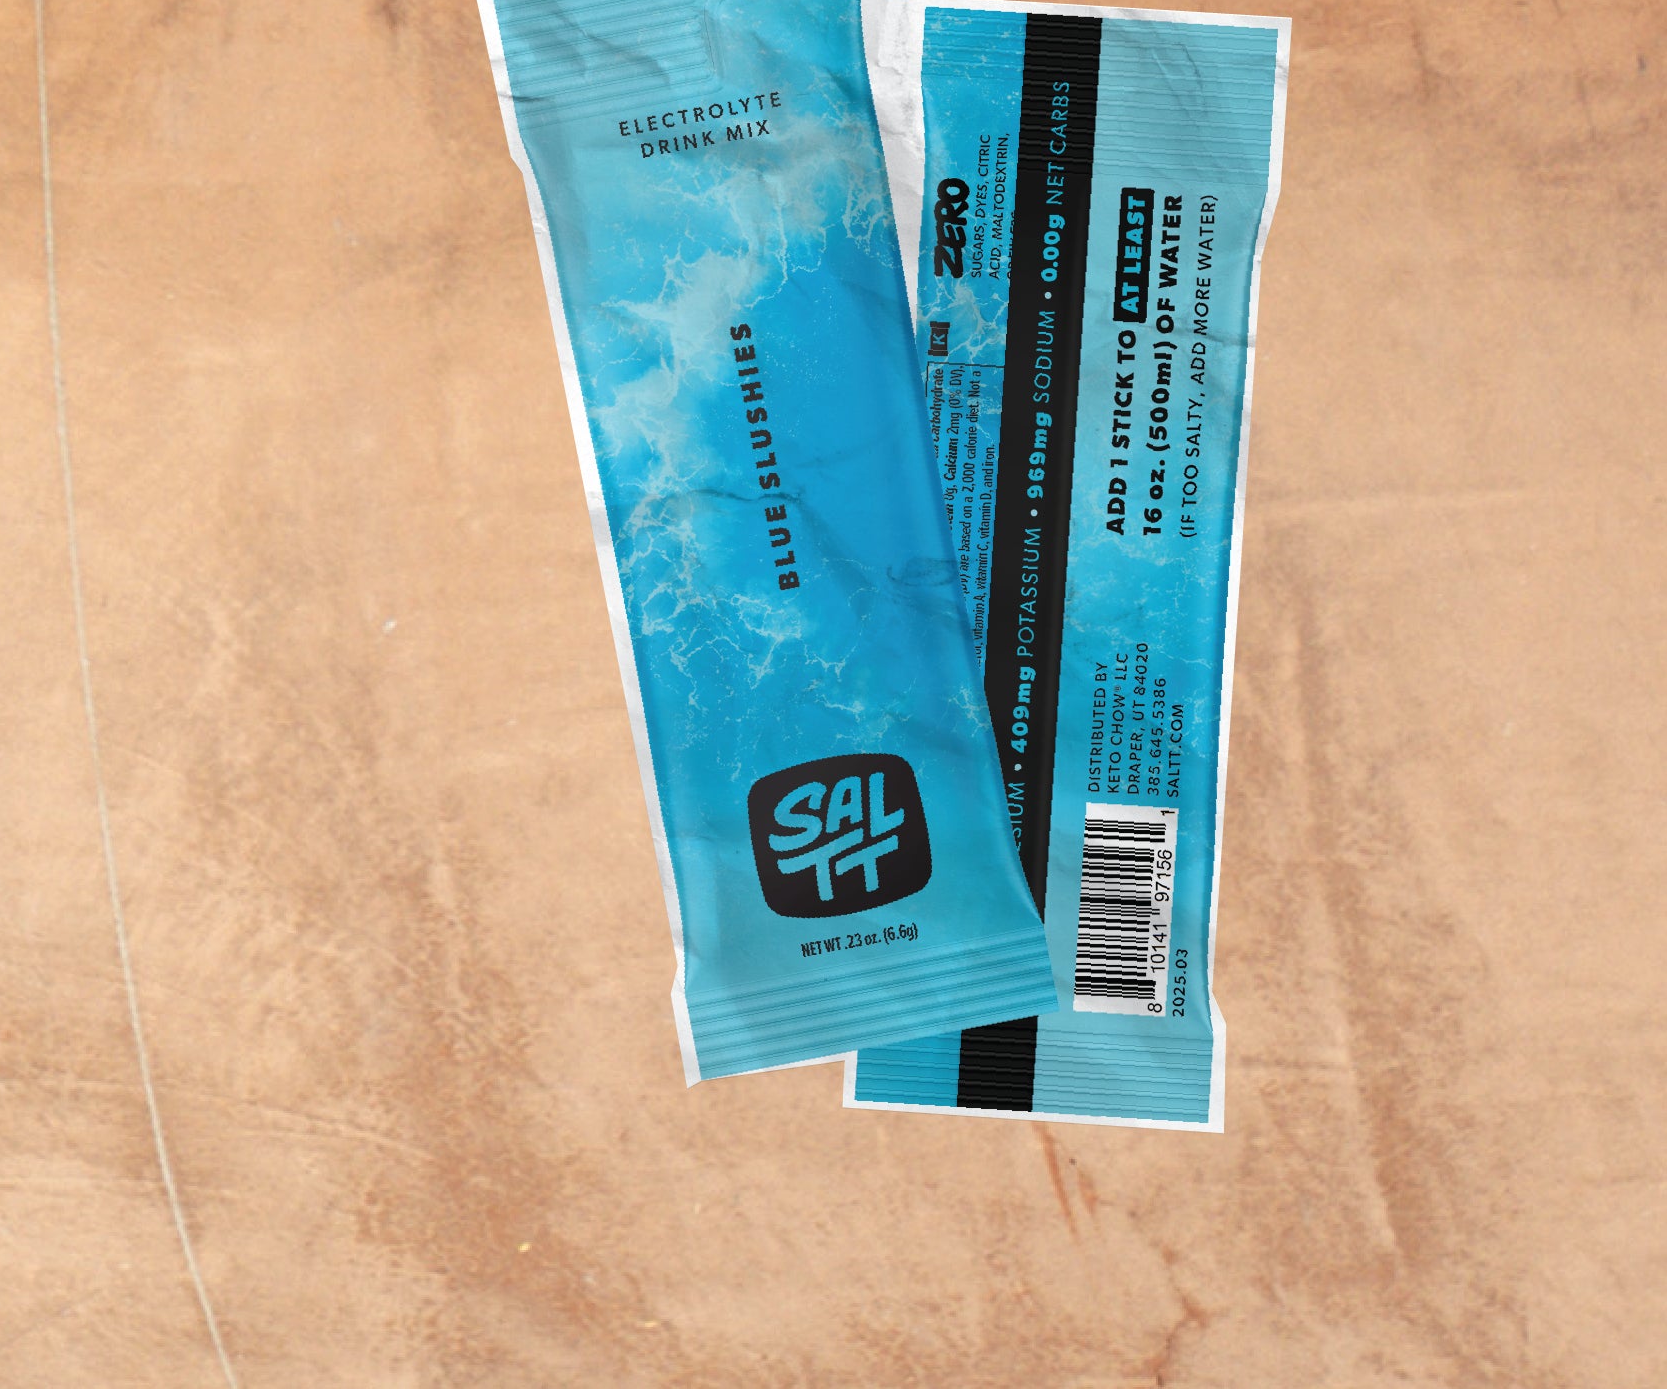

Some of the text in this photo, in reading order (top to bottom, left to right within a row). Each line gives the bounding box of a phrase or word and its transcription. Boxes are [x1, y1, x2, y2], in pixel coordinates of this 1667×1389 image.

[618, 91, 782, 137] ELECTROLYTE
[640, 119, 770, 159] DRINK MIX
[1040, 81, 1070, 282] 0.00g NET CARBS
[933, 177, 970, 278] ZERO
[970, 134, 991, 279] SUGARS, DYES, CITRIC
[988, 133, 1010, 280] ACID, MALTODEXTRIN,
[967, 380, 981, 398] Not
[1106, 195, 1146, 536] ADD 1 STICK TO AT LEAST
[1142, 195, 1183, 536] 16 oz. (500ml) OF WATER
[1179, 195, 1219, 538] (IF TOO SALTY, ADD MORE WATER)
[946, 412, 962, 435] 2mg
[1026, 310, 1056, 499] 969mg SODIUM
[729, 323, 800, 591] BLUE SLUSHIES
[943, 437, 959, 481] Calcium
[963, 426, 978, 460] calorie
[981, 444, 995, 467] iron.
[961, 462, 976, 493] 2,000
[981, 468, 994, 488] and
[963, 505, 973, 519] on
[977, 501, 992, 540] vitamin
[957, 521, 972, 552] based
[974, 552, 988, 590] vitamin
[1016, 528, 1042, 657] POTASSIUM
[971, 602, 985, 641] vitamin
[1114, 653, 1129, 681] LLC
[1010, 666, 1037, 754] 409mg
[1087, 662, 1108, 793] DISTRIBUTED BY
[1127, 642, 1149, 795] DRAPER, UT 84020
[1147, 678, 1167, 796] 385.645.5386
[1166, 704, 1184, 798] SALTT.COM
[1107, 751, 1122, 793] KETO
[1154, 849, 1173, 902] 97156
[800, 922, 919, 958] NET WT .23 oz. (6.6g)
[1150, 924, 1168, 974] 10141
[1172, 948, 1189, 1017] 2025.03
[1147, 1002, 1163, 1014] 8
